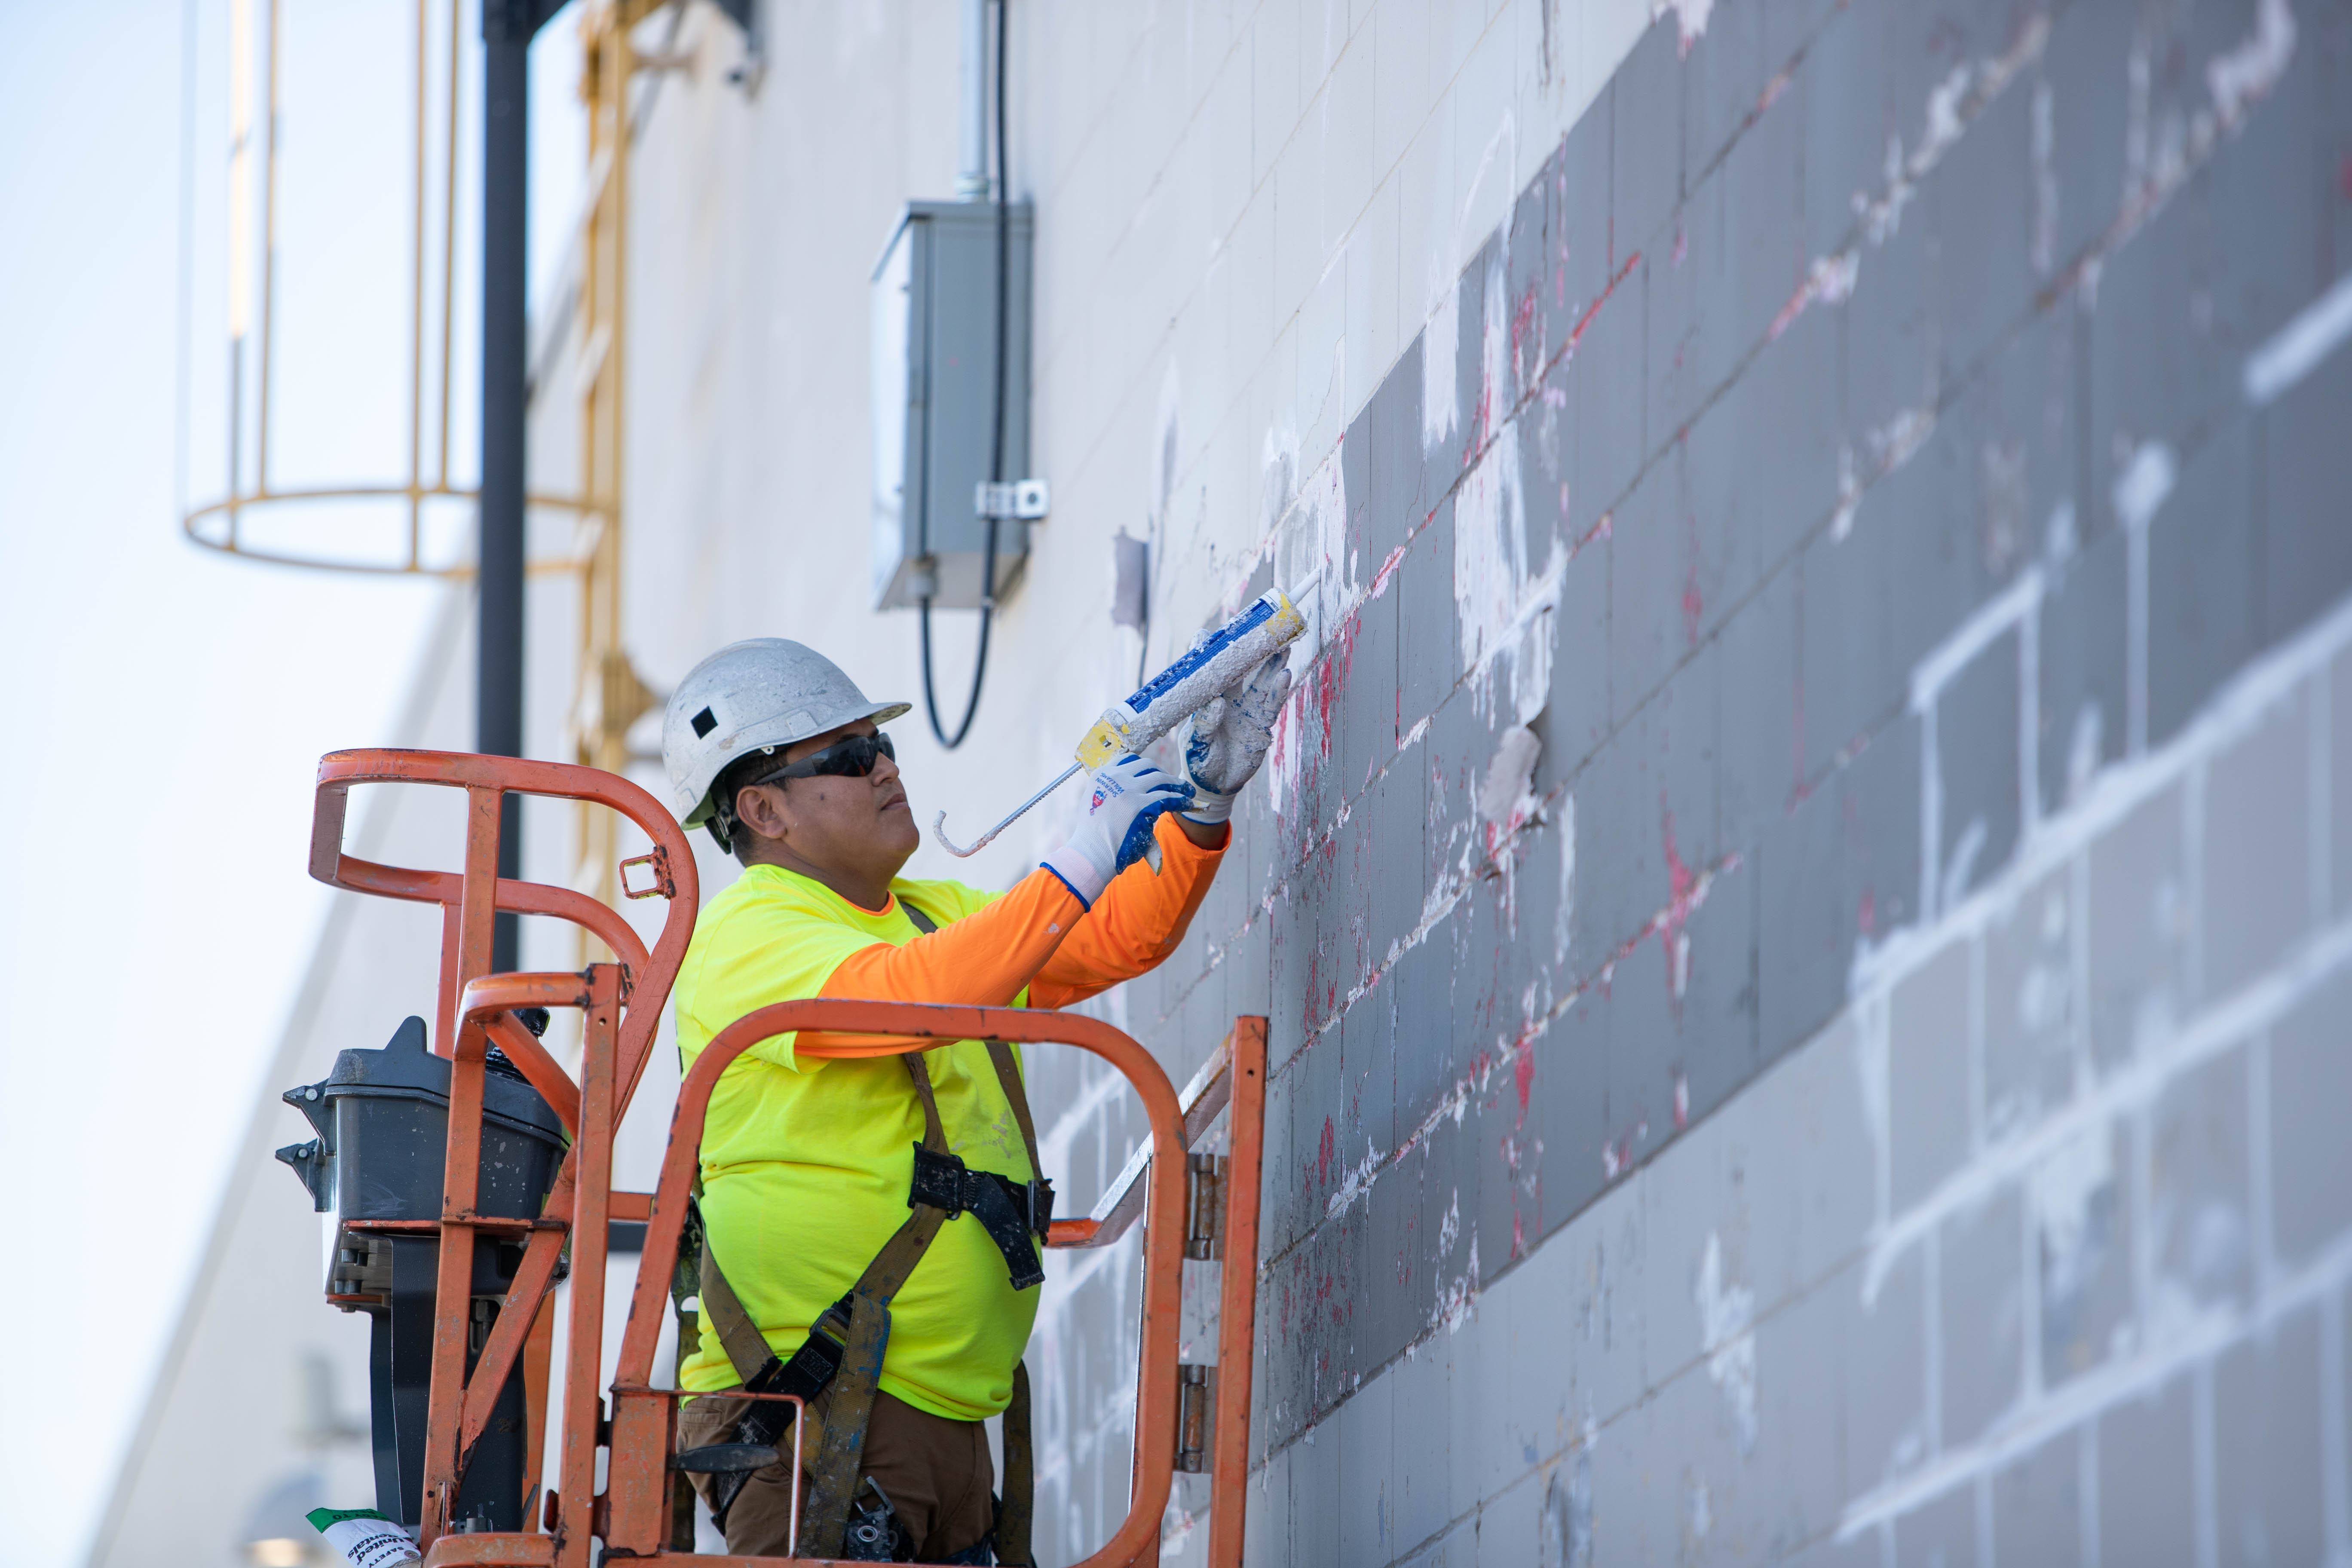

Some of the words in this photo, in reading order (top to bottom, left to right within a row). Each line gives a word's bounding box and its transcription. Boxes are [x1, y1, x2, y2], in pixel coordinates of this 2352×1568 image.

[1270, 602, 1280, 612] WHITE
[1095, 777, 1119, 798] SHERWIN
[1100, 772, 1125, 793] WILLIAMS
[347, 1534, 398, 1559] Rentals
[357, 1538, 404, 1563] United
[368, 1547, 404, 1568] SAFETY
